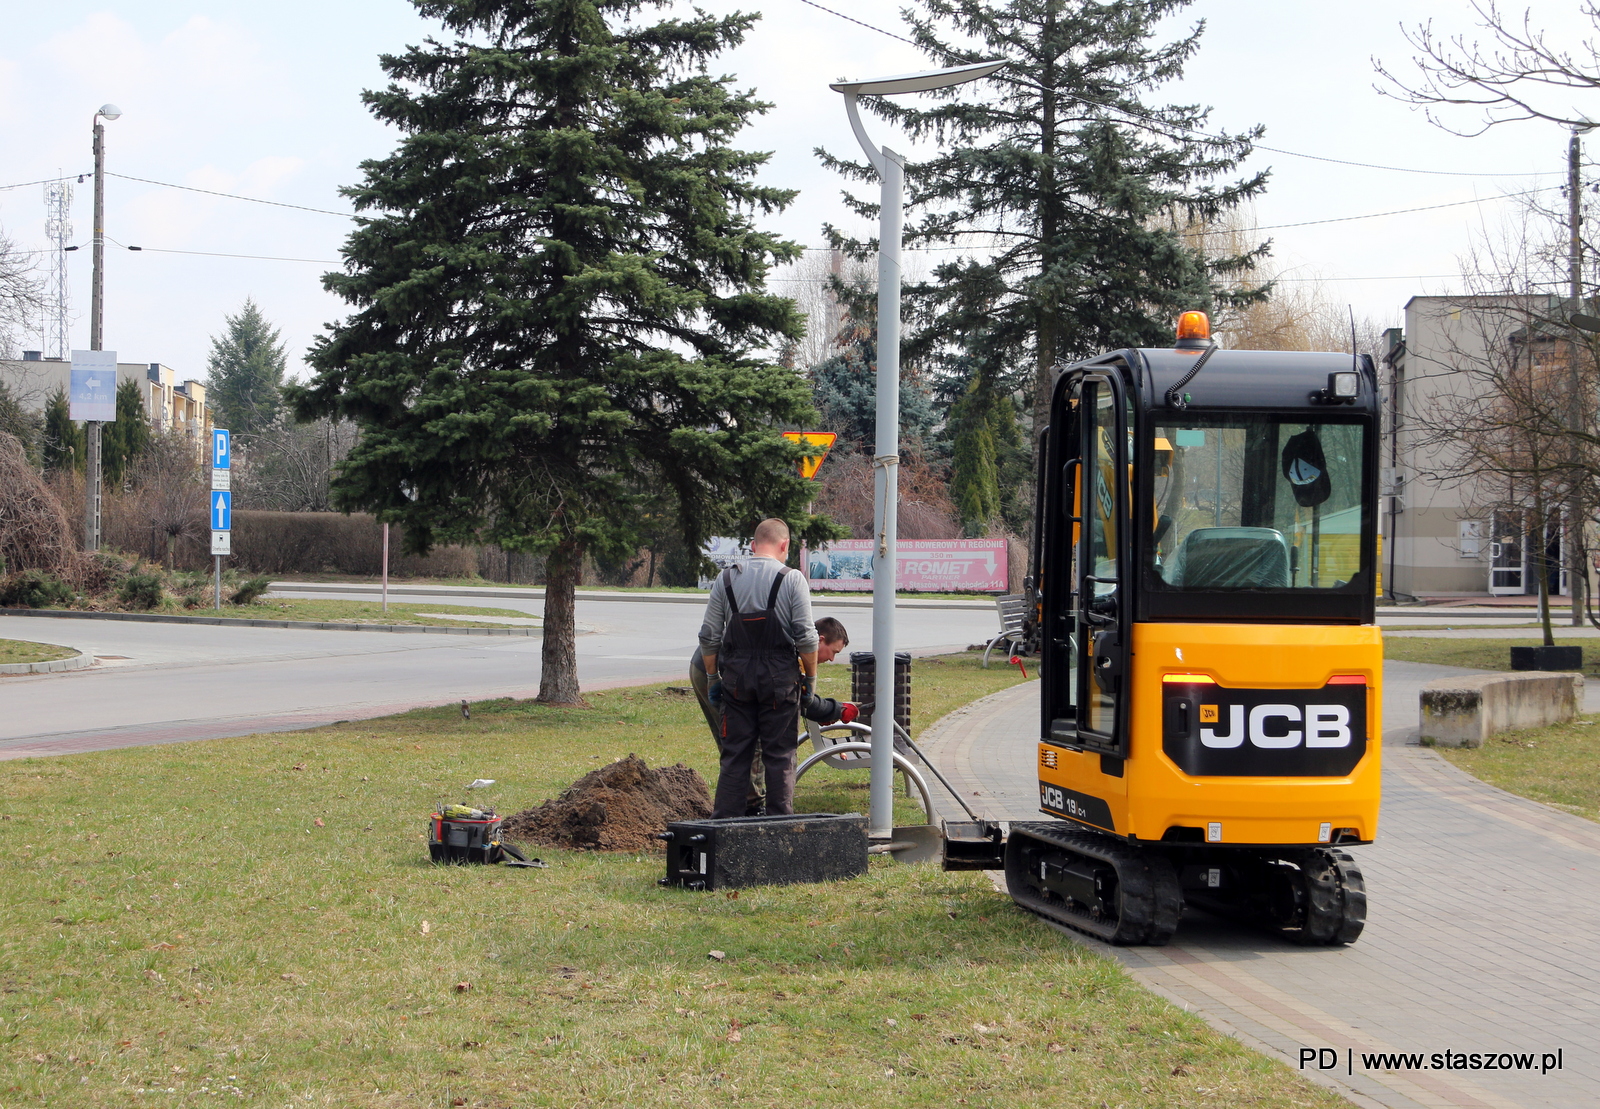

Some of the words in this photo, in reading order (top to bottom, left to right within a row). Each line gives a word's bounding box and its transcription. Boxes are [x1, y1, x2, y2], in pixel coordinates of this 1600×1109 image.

[216, 433, 227, 464] P
[854, 541, 874, 549] SALO
[896, 541, 913, 549] RWIS
[915, 541, 958, 549] ROWEROWY
[968, 540, 1004, 548] REGIONIE
[904, 561, 974, 575] ROMET
[810, 580, 820, 588] otr
[1200, 704, 1351, 749] JCB
[1041, 785, 1063, 810] JCB
